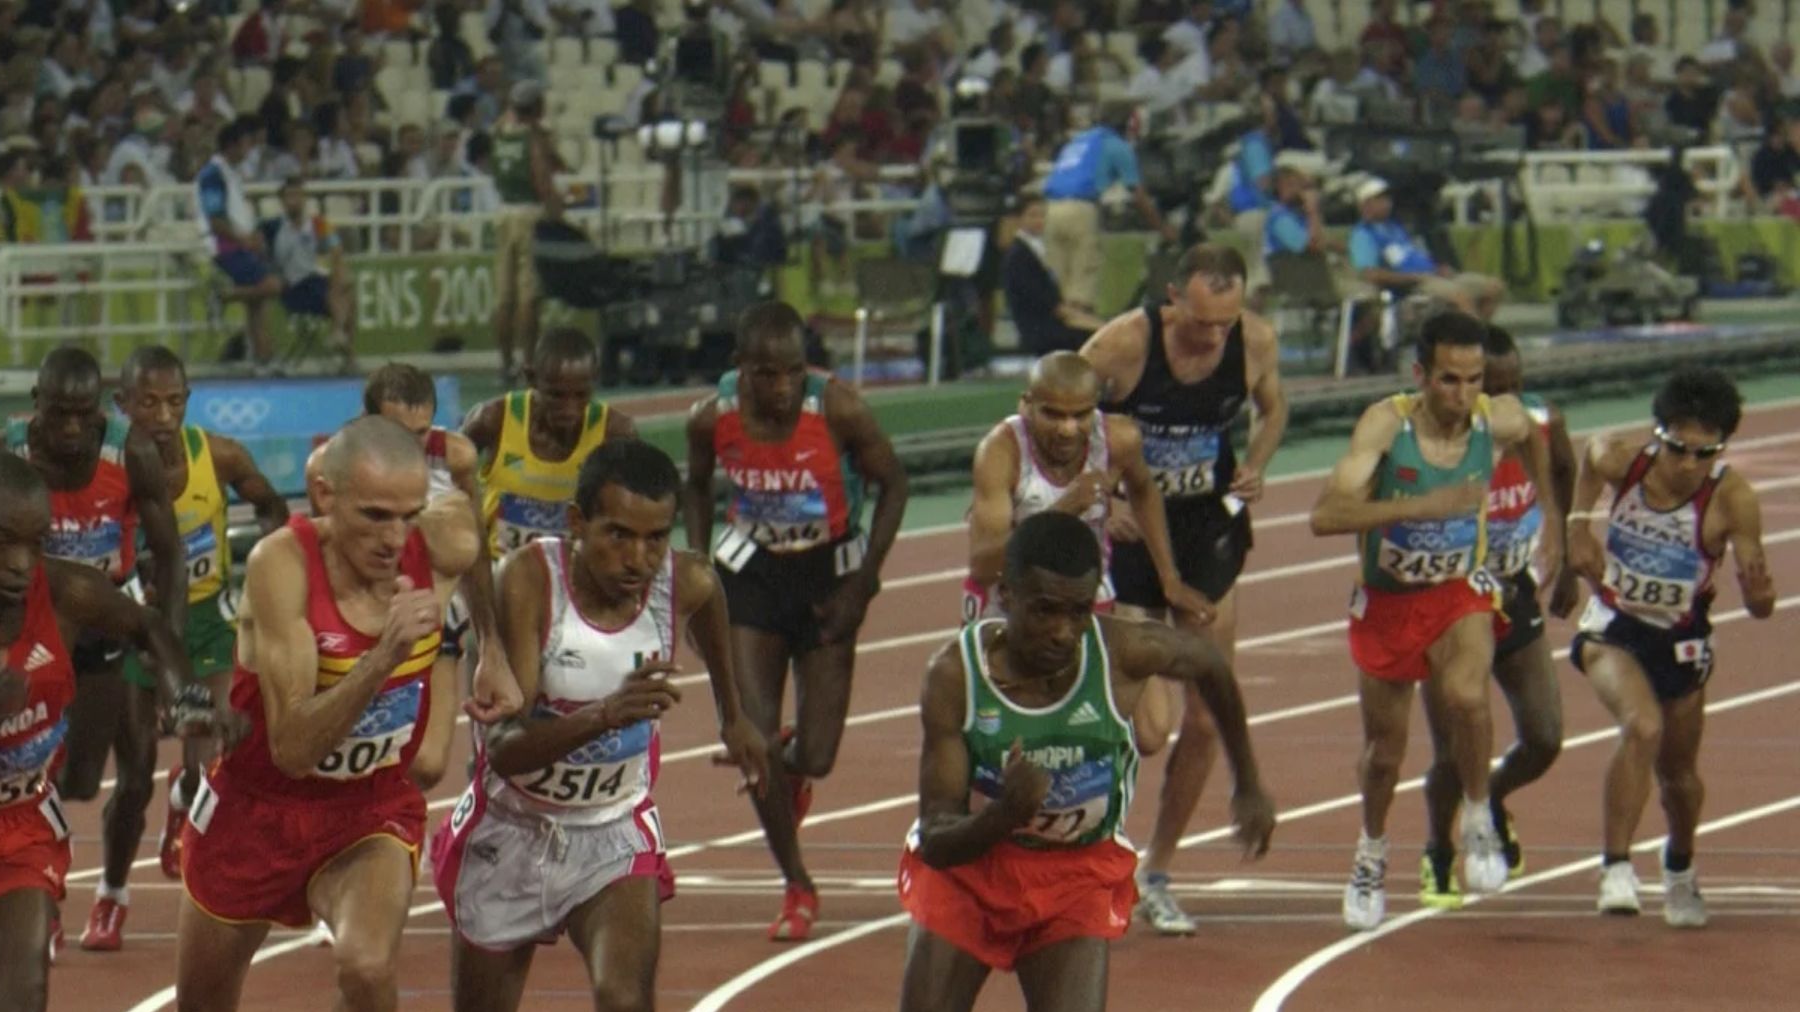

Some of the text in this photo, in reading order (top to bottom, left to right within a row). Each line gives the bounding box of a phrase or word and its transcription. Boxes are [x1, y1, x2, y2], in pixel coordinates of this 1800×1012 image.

[431, 266, 492, 327] 200
[729, 468, 818, 490] KENYA
[525, 763, 627, 801] 2514
